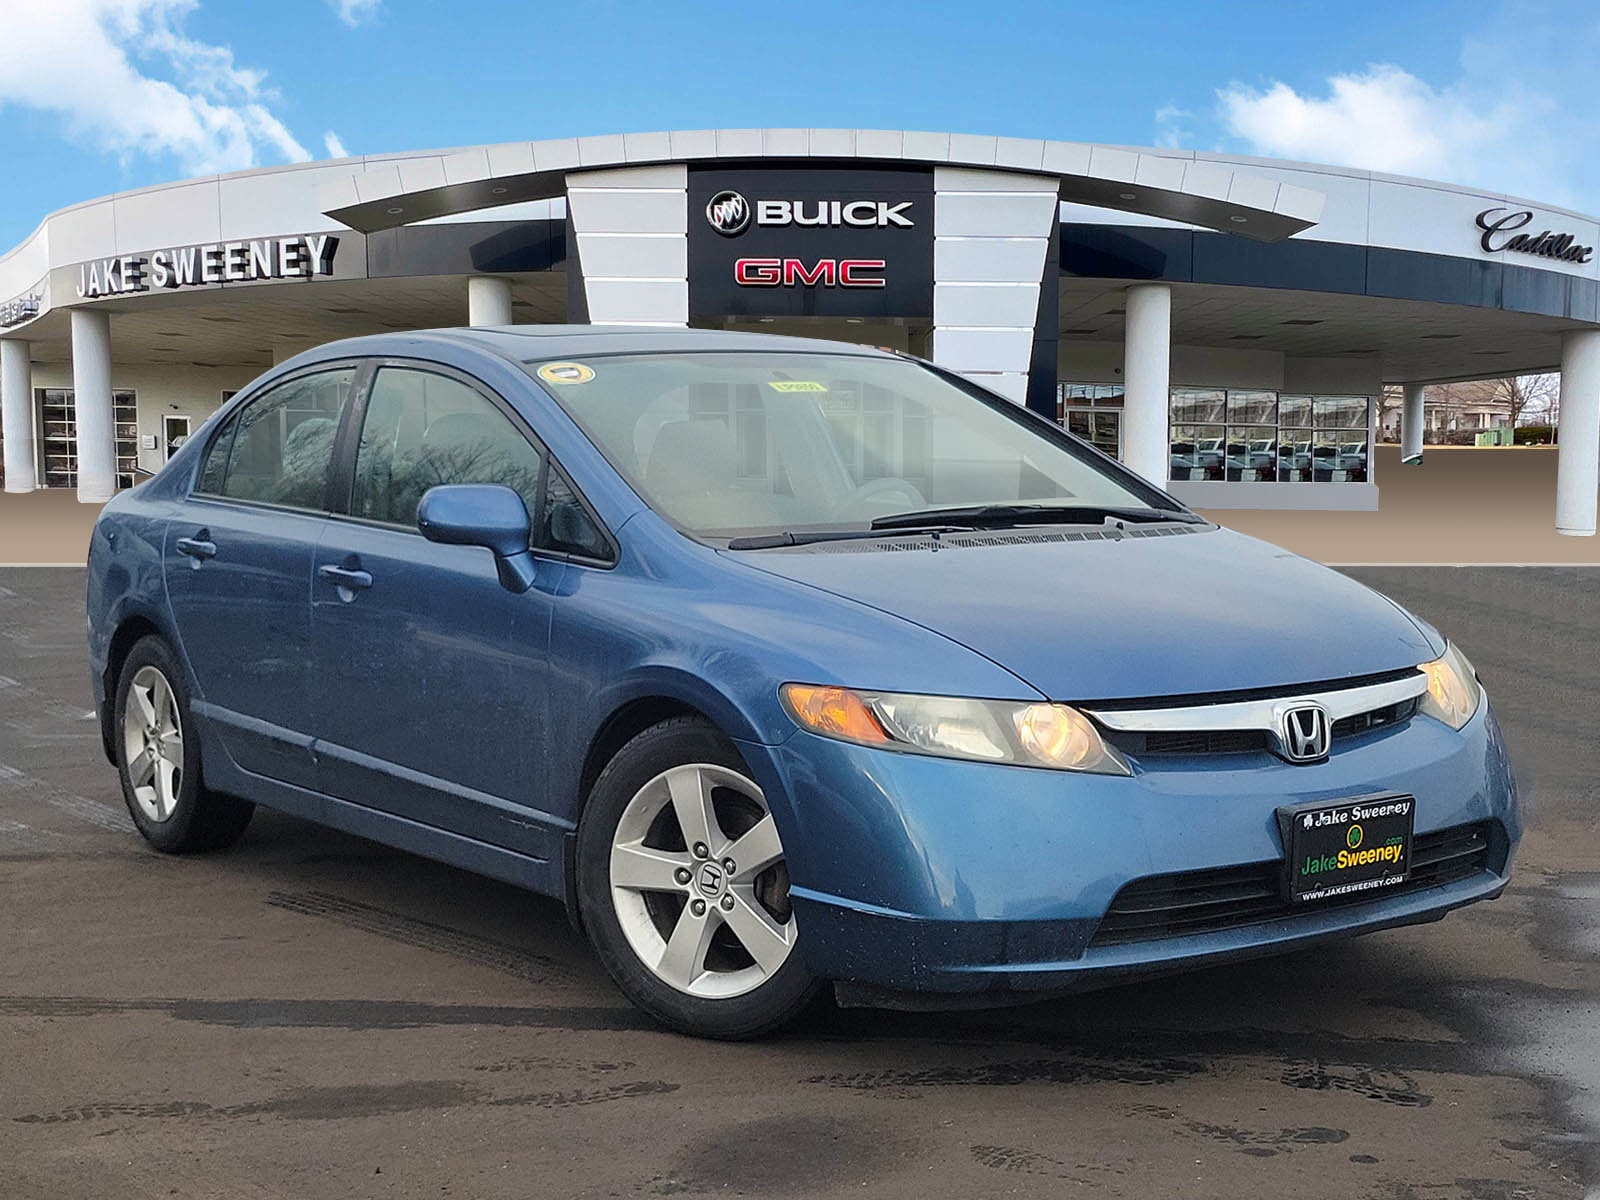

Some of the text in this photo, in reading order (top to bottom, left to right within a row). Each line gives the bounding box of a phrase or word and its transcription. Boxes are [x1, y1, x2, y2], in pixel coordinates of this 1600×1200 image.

[757, 200, 915, 227] BUICK
[1475, 207, 1594, 264] Cadillac
[76, 235, 334, 298] JAKE SWEENEY
[735, 257, 886, 287] GMC
[1314, 801, 1411, 828] Jake Sweeney
[1302, 876, 1404, 901] WWW.JAKESWEENEY.COM
